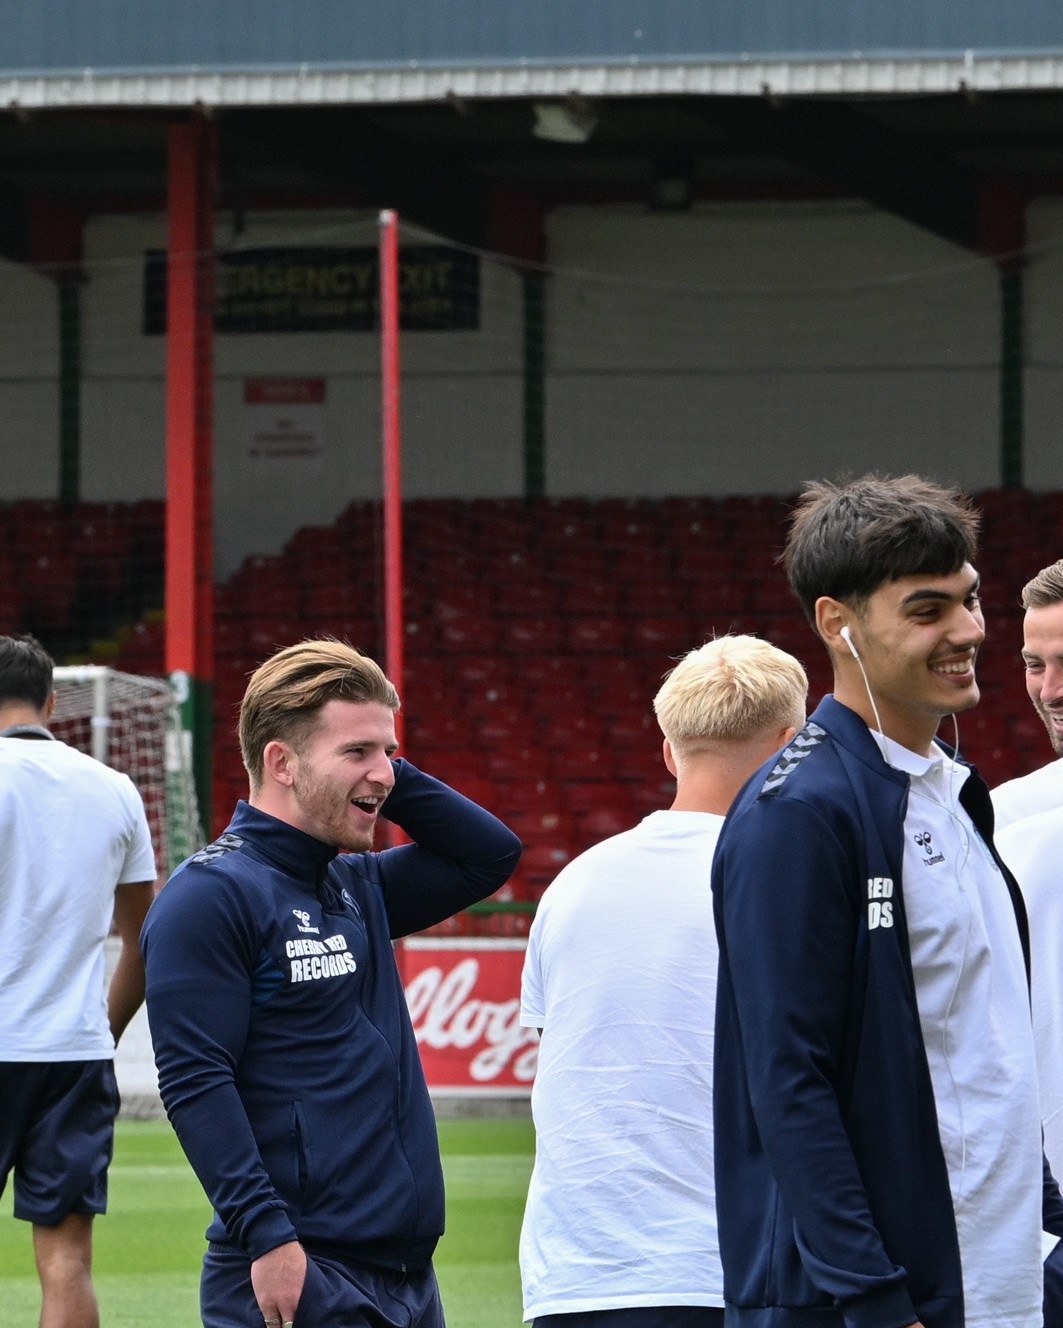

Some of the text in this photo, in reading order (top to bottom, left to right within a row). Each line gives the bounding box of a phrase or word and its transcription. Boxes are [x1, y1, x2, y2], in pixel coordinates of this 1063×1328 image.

[218, 261, 452, 293] ERGENCY XIT
[323, 934, 348, 952] RED
[291, 952, 356, 983] RECORDS
